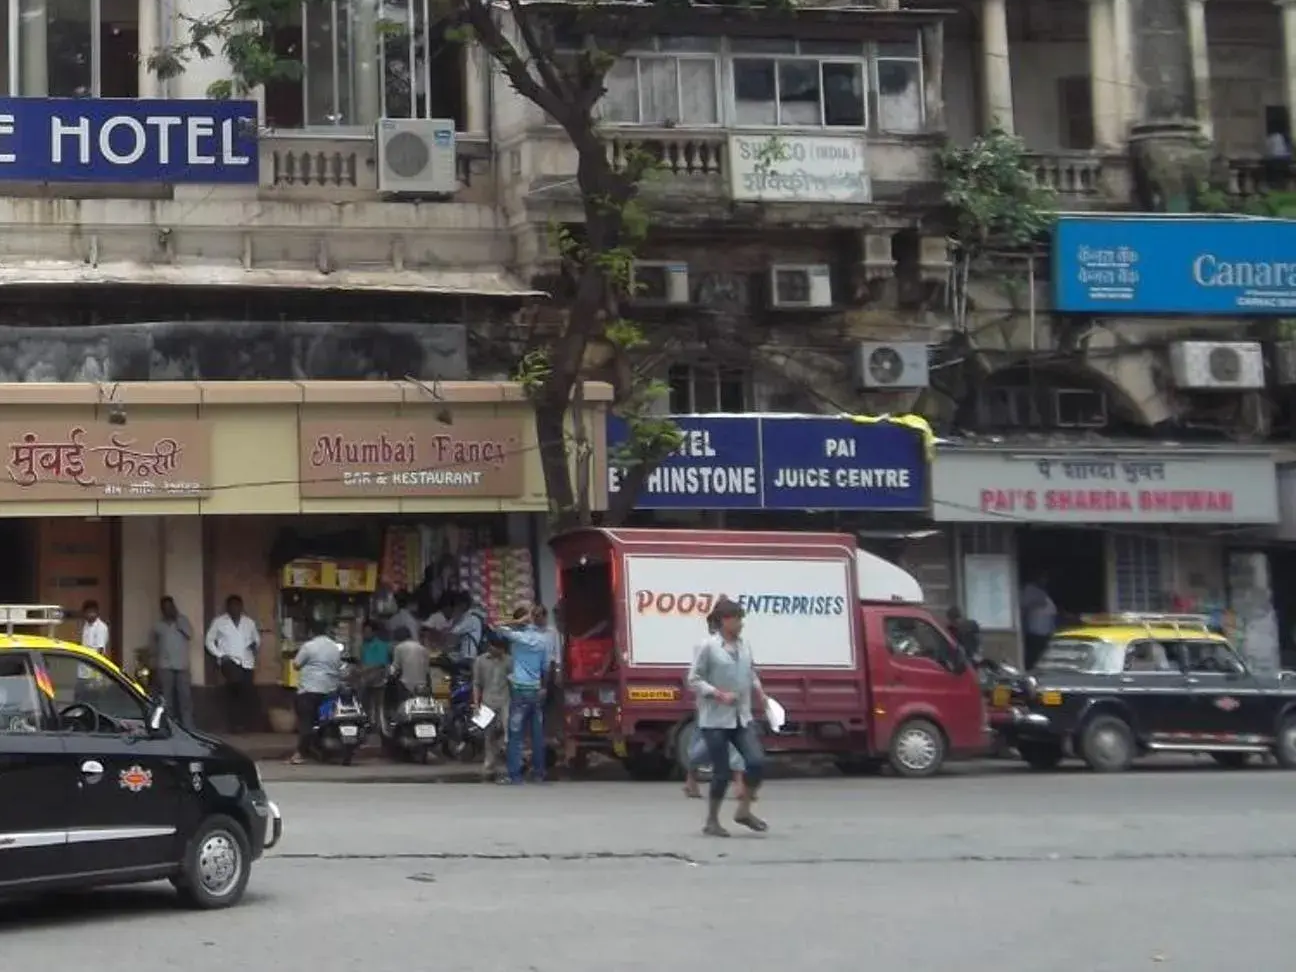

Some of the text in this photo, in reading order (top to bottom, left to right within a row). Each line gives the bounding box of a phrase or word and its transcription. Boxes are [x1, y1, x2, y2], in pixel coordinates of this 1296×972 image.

[51, 115, 250, 165] HOTEL
[311, 435, 416, 467] Mumbai
[825, 438, 856, 458] PAI
[608, 466, 757, 495] EHINSTONE
[774, 468, 911, 488] JUICE CENTRE
[979, 488, 1037, 511] PAI'S
[737, 594, 845, 616] ENTERPRISES
